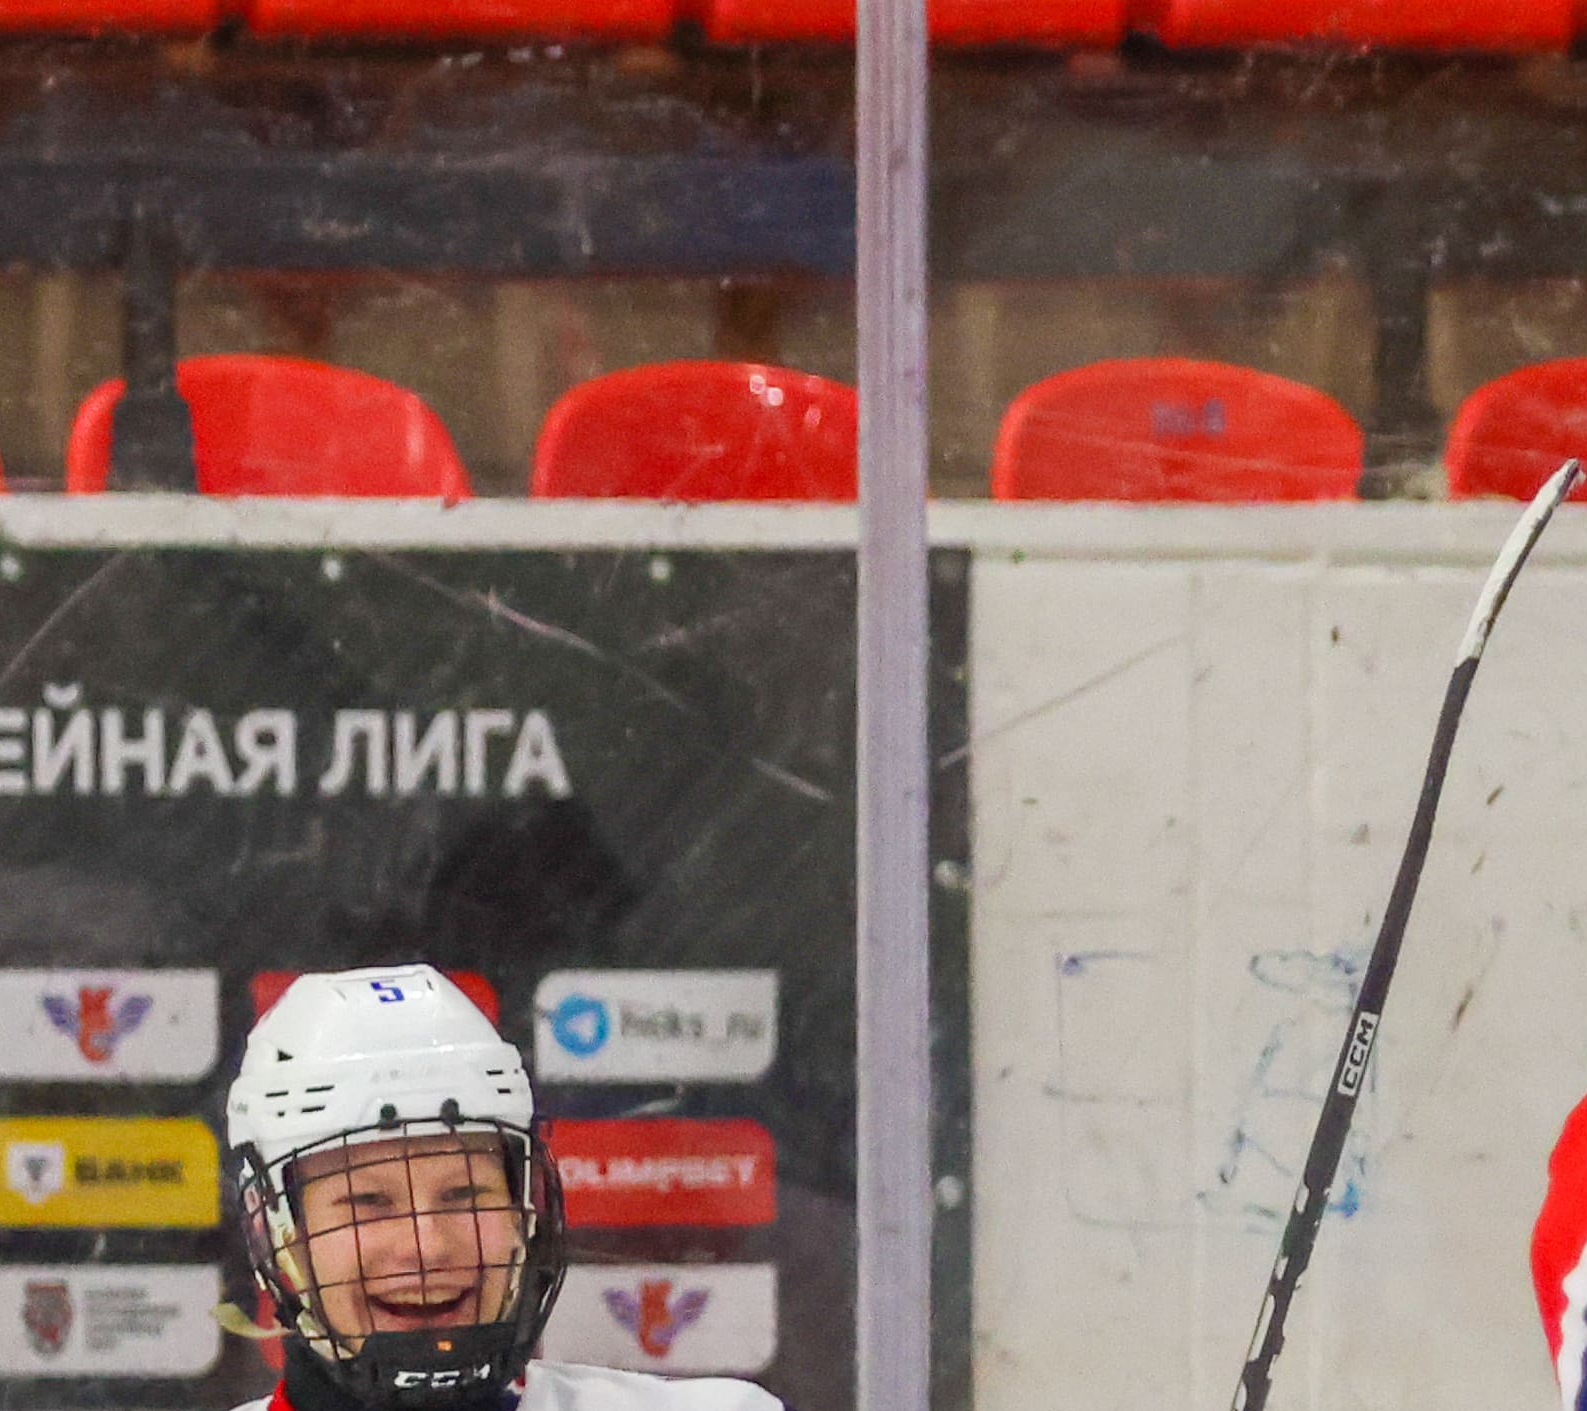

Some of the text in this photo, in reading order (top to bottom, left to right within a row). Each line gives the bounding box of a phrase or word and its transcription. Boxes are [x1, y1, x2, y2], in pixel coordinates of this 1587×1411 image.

[318, 708, 574, 798] ЛИГА
[370, 980, 405, 1003] 5
[1342, 1016, 1378, 1093] CCM
